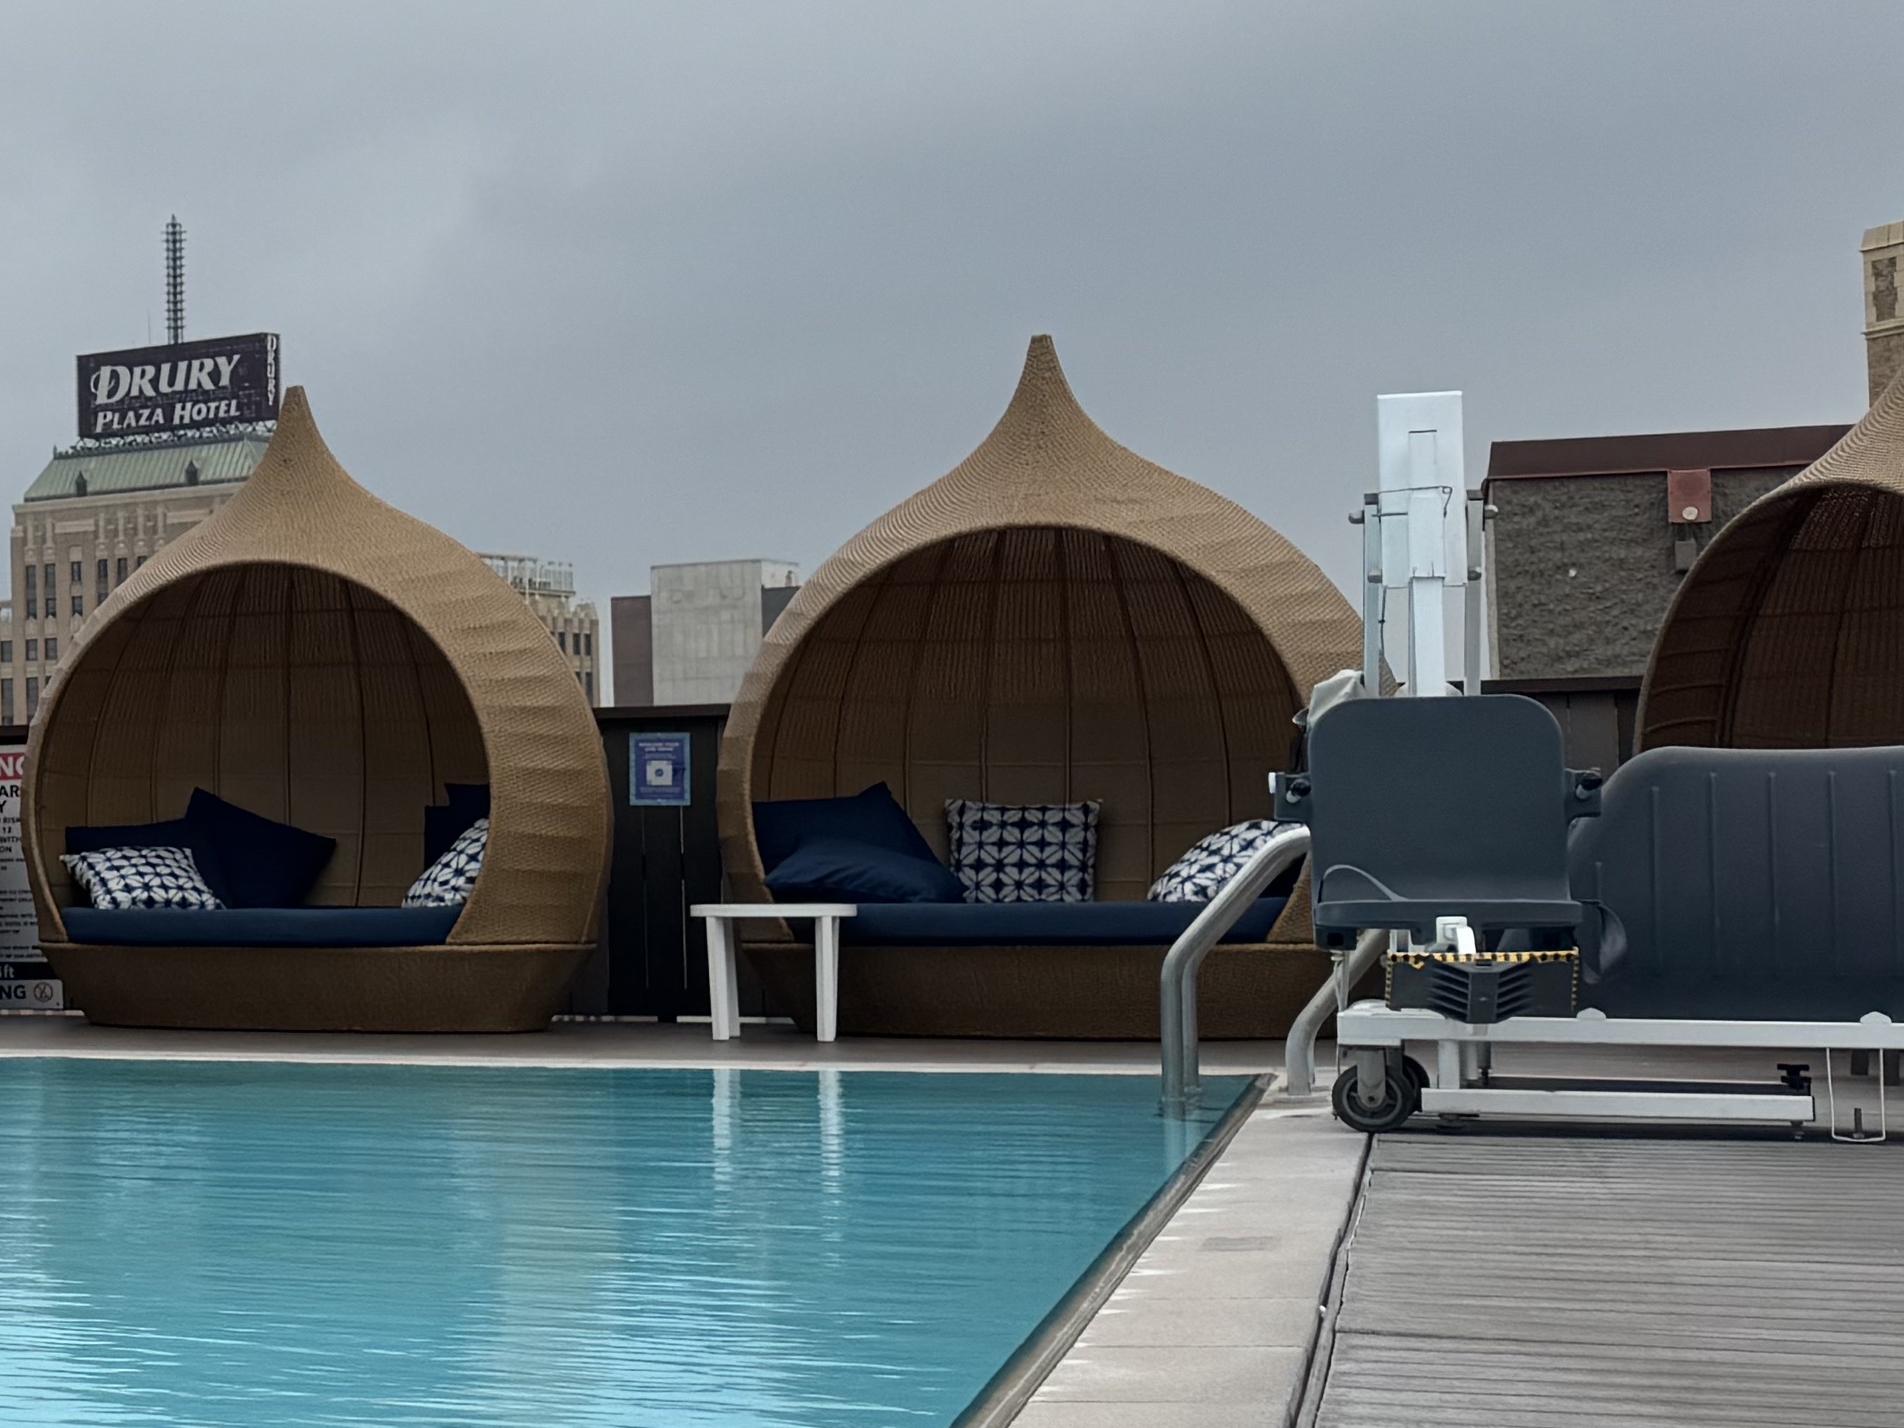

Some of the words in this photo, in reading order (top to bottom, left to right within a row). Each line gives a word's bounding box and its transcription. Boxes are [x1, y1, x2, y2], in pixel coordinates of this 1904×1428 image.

[90, 354, 241, 405] DRURY
[267, 334, 277, 406] DRURY
[95, 408, 164, 433] PLAZA
[172, 399, 241, 425] HOTEL
